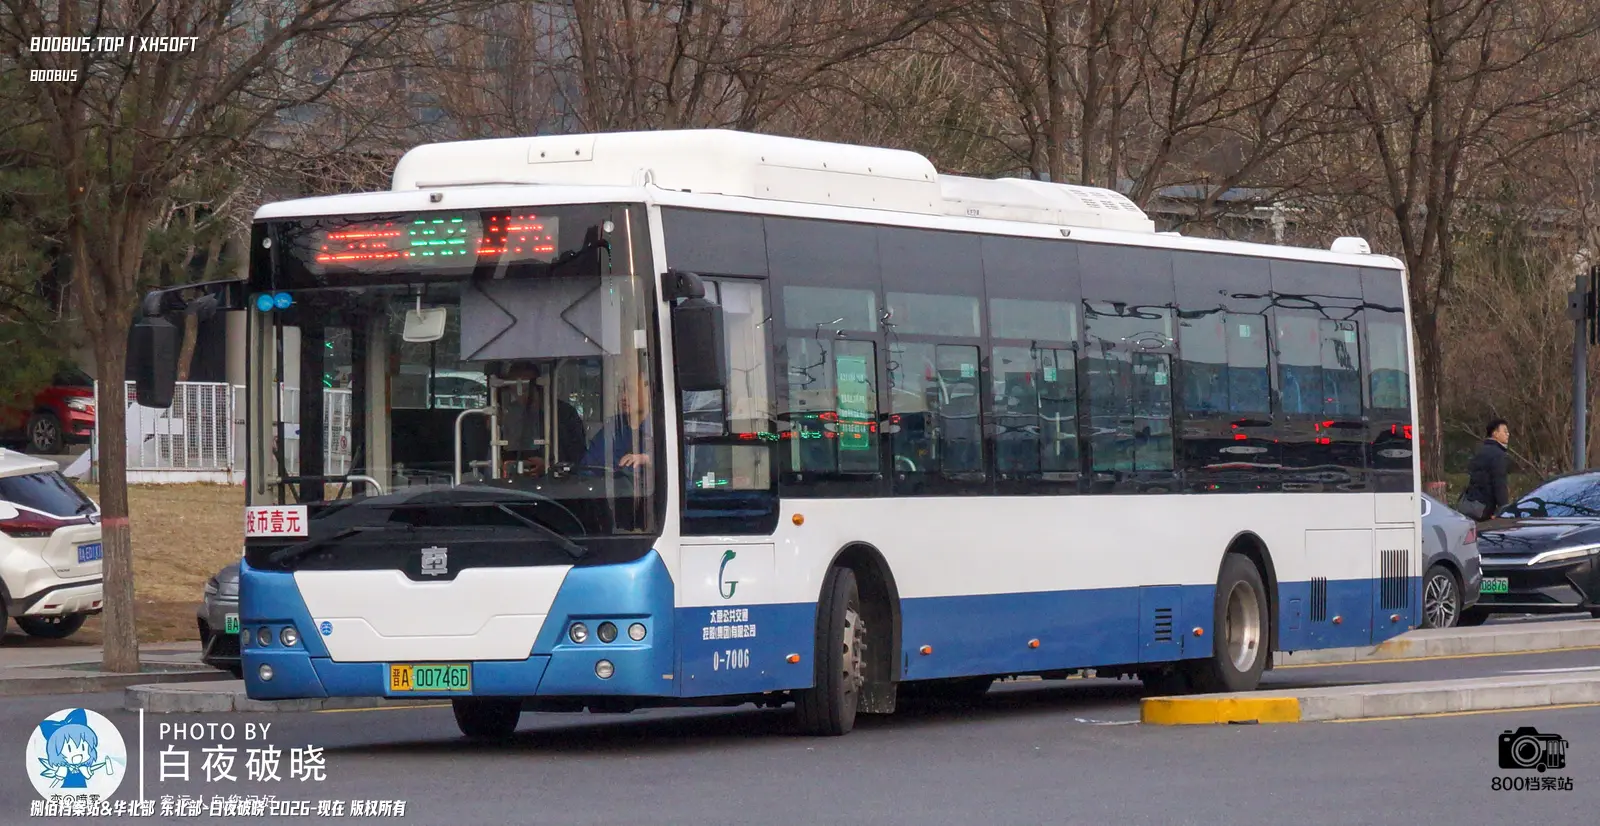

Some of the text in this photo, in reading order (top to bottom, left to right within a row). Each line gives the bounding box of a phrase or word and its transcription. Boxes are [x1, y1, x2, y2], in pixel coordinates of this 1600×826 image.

[246, 509, 302, 534] 投币壹元
[713, 648, 750, 672] 0-7006
[416, 668, 469, 687] 00746D
